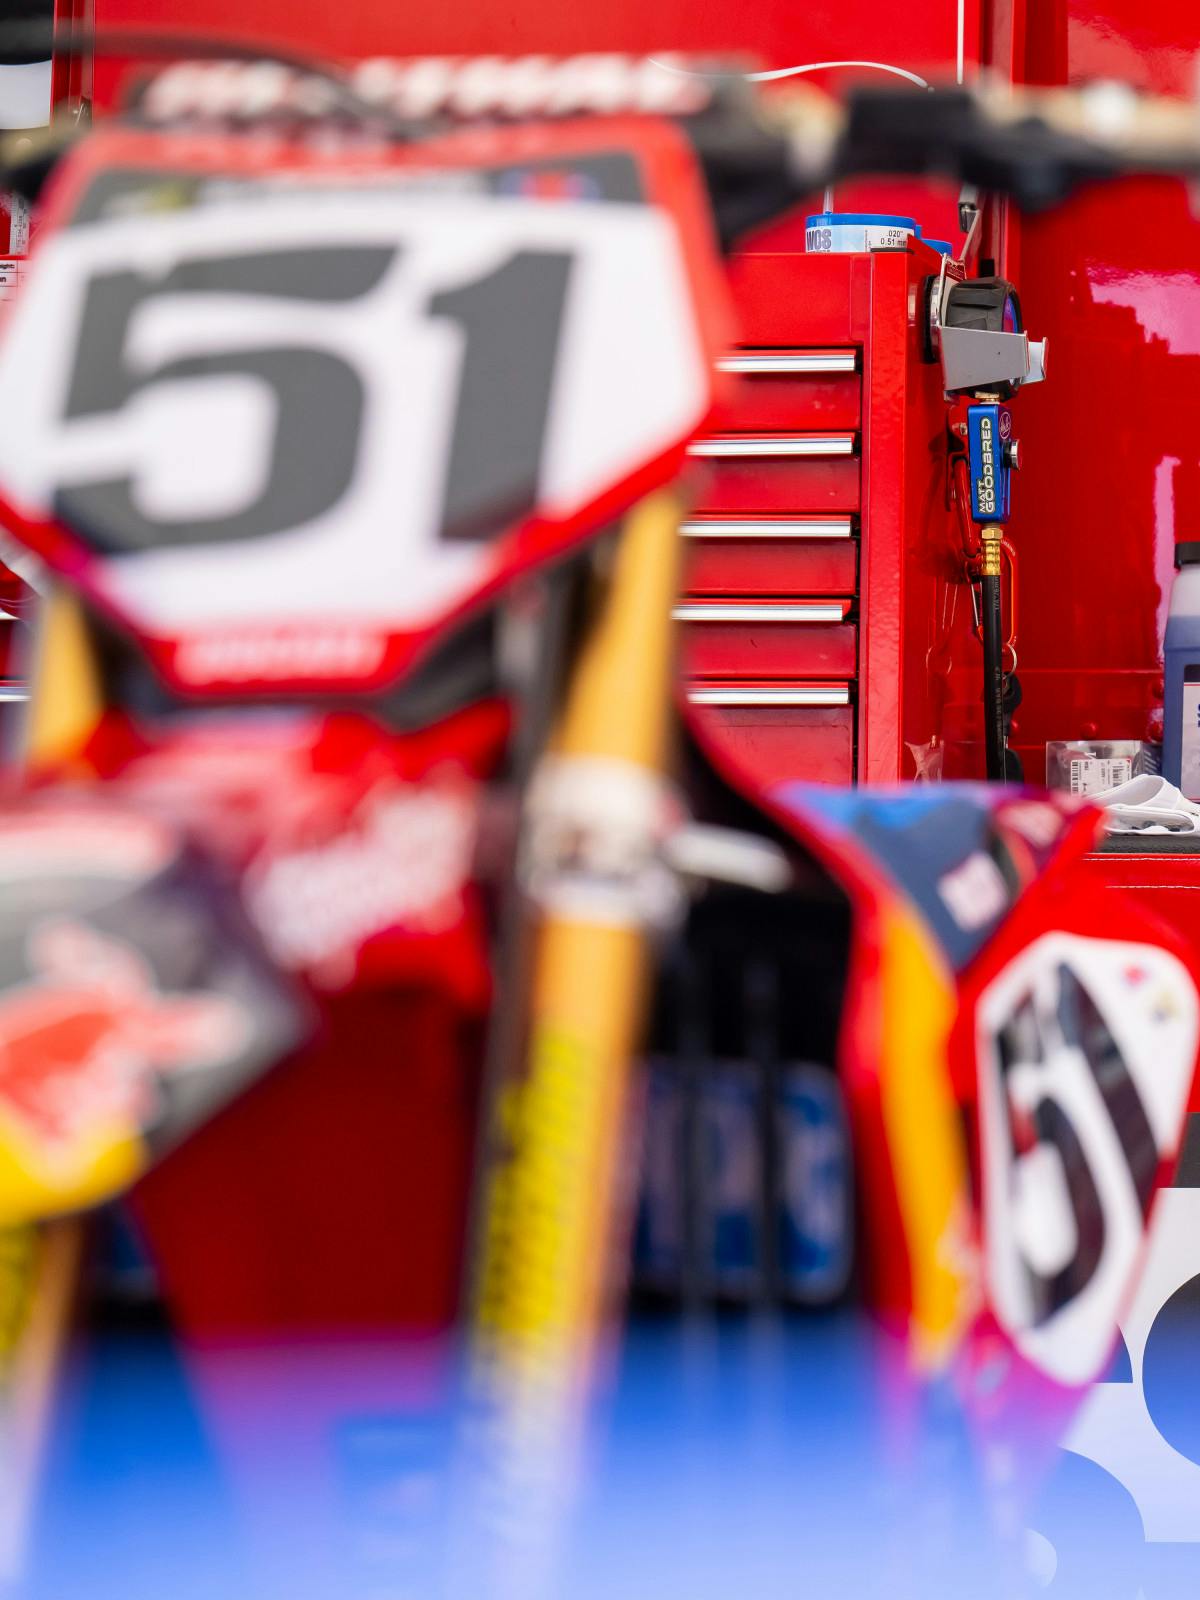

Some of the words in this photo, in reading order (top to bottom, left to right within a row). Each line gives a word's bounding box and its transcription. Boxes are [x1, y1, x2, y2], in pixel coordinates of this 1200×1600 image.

[50, 244, 578, 560] 51
[978, 480, 987, 513] MATT
[981, 417, 996, 513] GOODBRED
